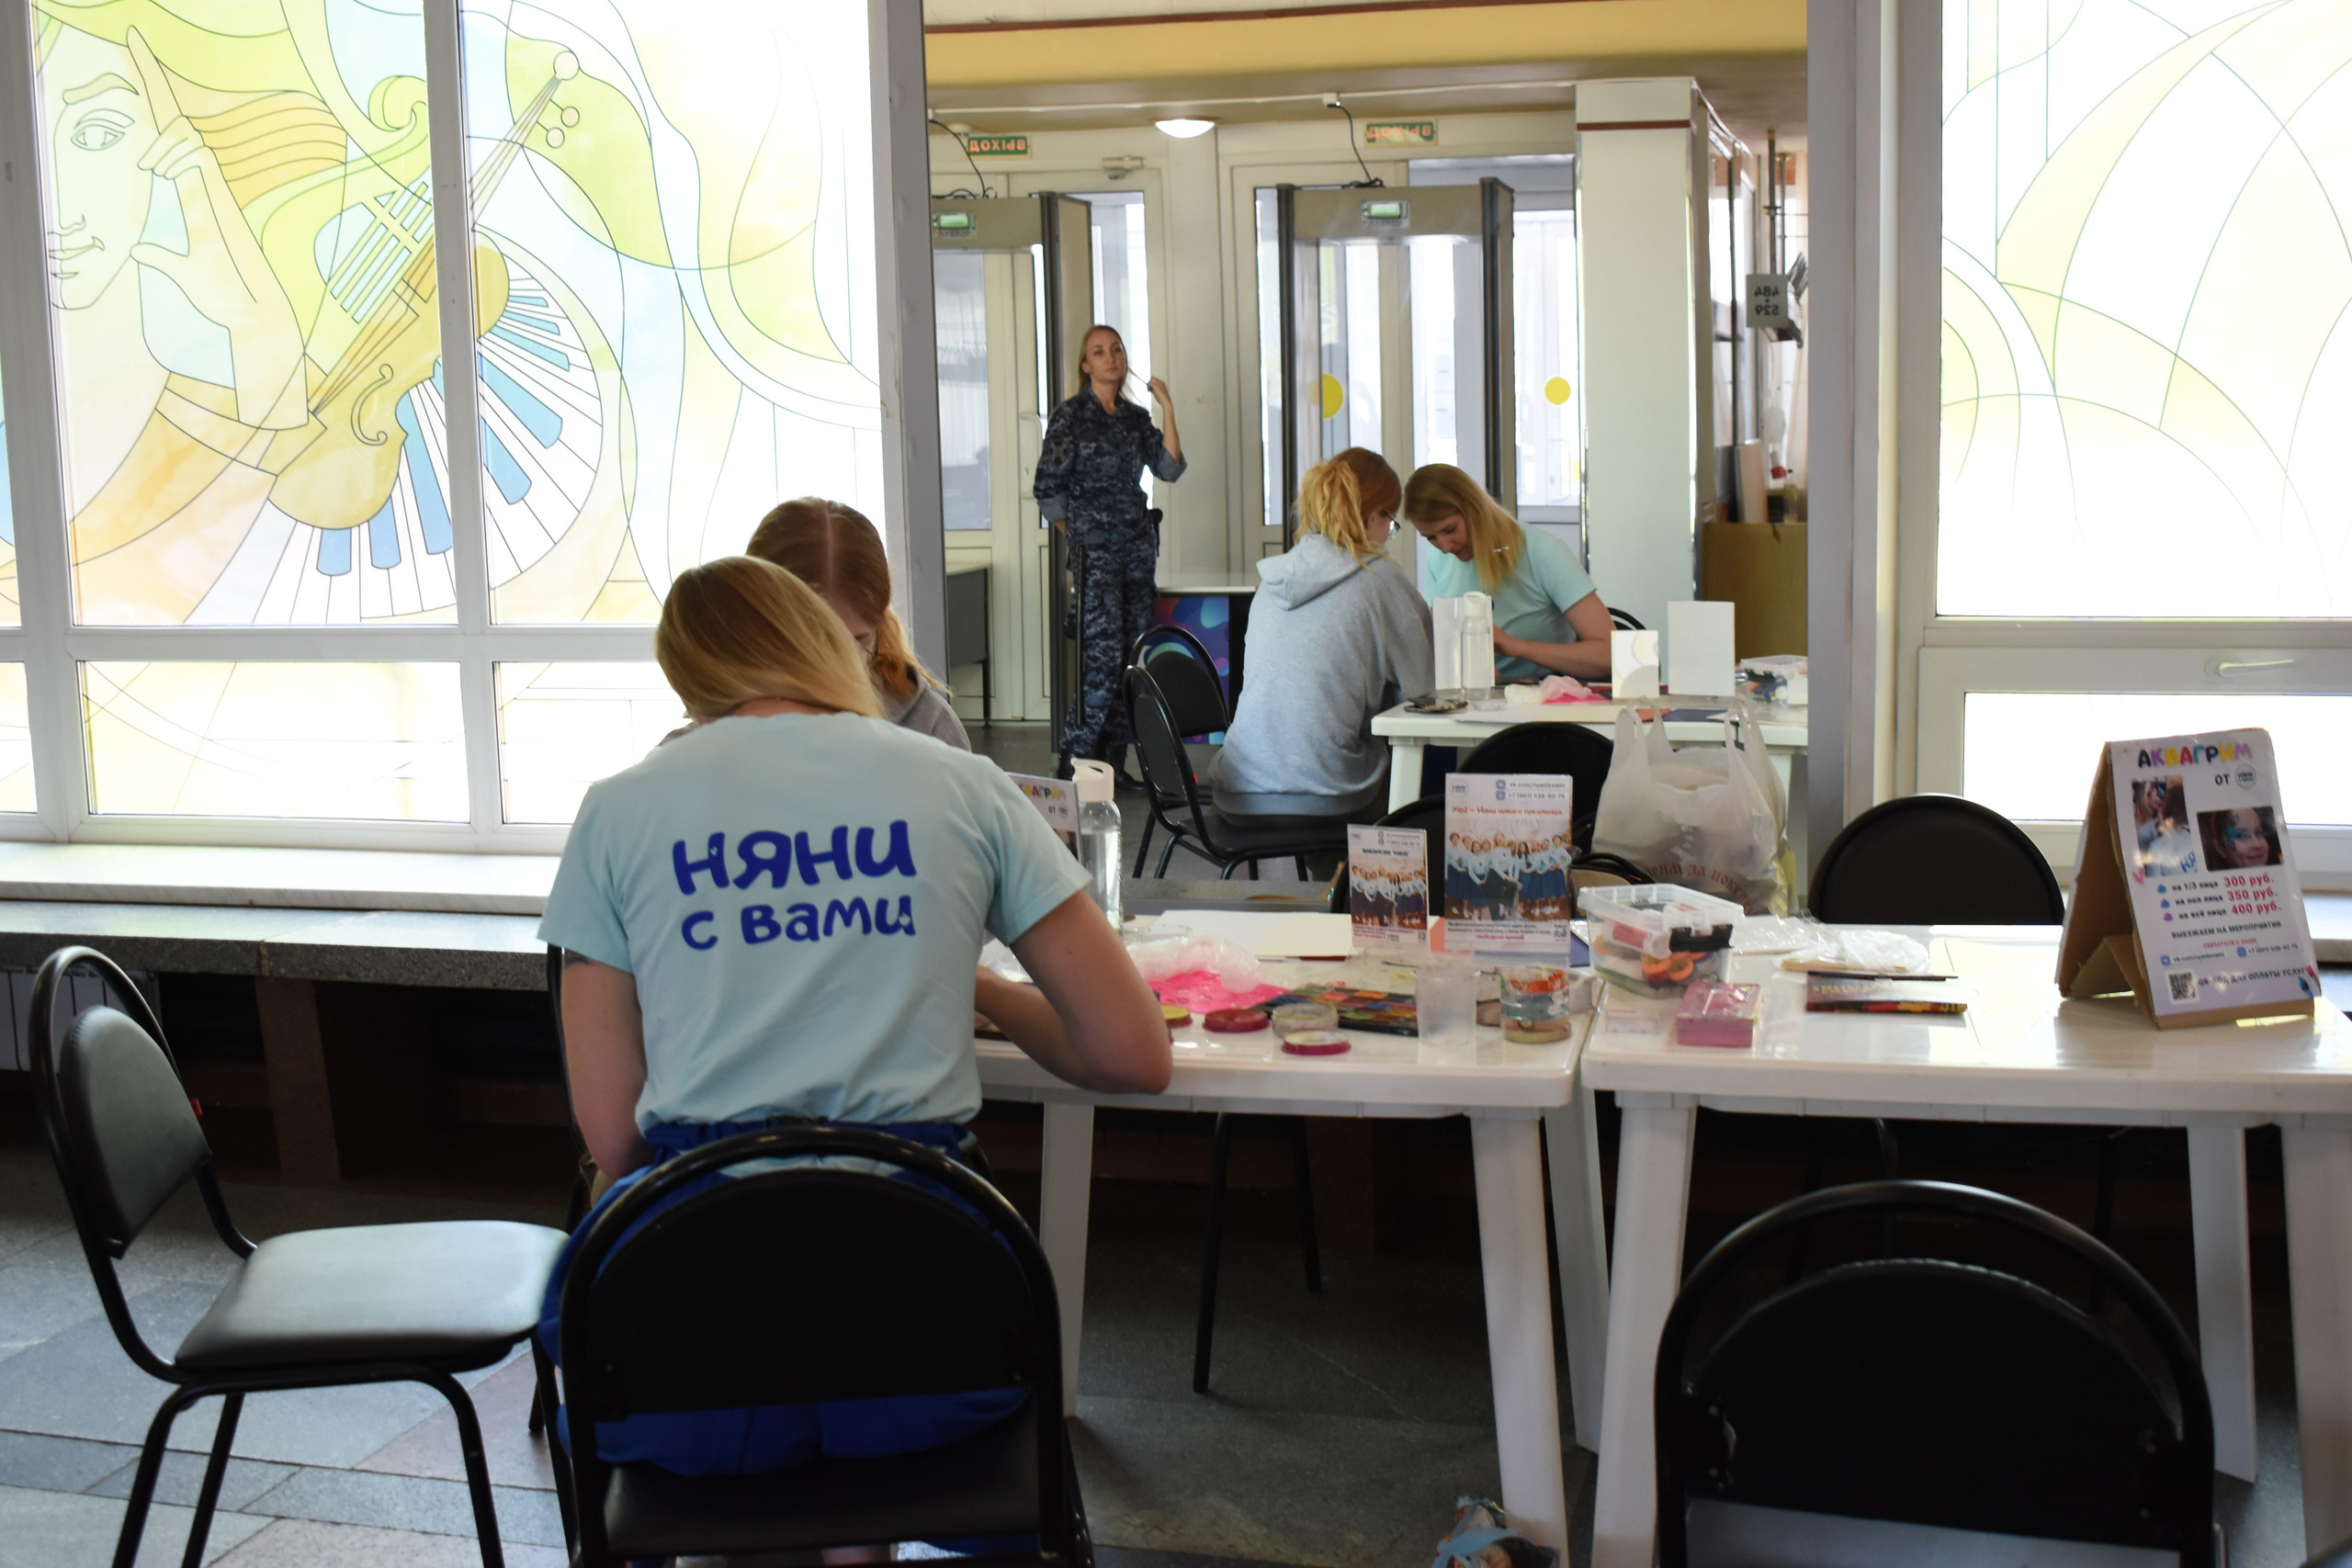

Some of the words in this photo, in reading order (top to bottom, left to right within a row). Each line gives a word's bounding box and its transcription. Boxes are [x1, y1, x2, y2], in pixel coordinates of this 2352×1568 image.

[2138, 742, 2252, 768] АКВАГРИМ
[673, 819, 917, 896] НЯНИ
[2184, 882, 2197, 890] 1/3
[2223, 875, 2245, 887] 300
[2249, 873, 2274, 887] руб.
[2227, 889, 2249, 902] 350
[2253, 886, 2278, 901] руб.
[2232, 903, 2253, 915] 400
[2256, 900, 2281, 915] руб.
[2171, 928, 2215, 939] ВЫЕЗЖАЕМ
[2229, 920, 2281, 933] МЕРОПРИЯТИЯ
[2248, 970, 2281, 980] ОПЛАТЫ
